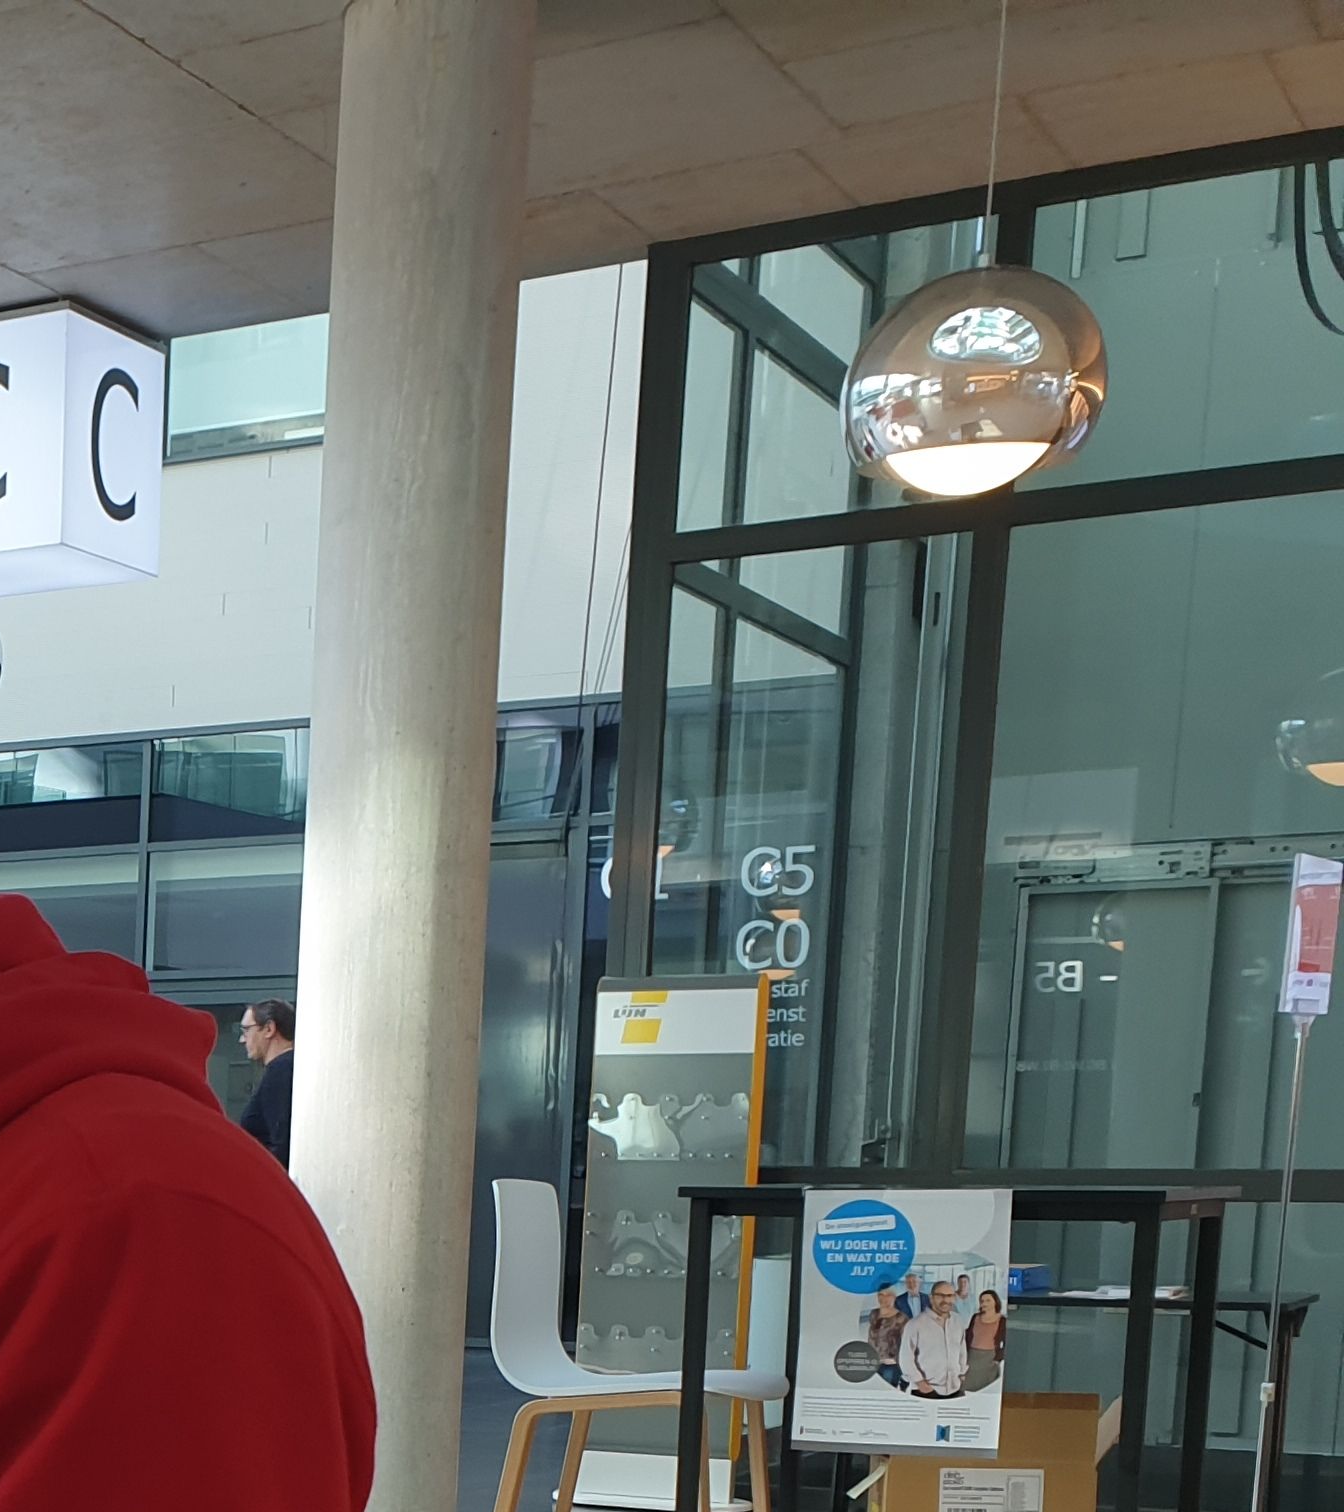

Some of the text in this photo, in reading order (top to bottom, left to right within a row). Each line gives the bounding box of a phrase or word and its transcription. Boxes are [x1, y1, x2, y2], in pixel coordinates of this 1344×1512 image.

[90, 367, 139, 522] C
[740, 844, 816, 897] C5
[735, 918, 811, 970] C0
[766, 1006, 807, 1023] enst
[826, 1253, 900, 1263] EN WAT DOE
[844, 1239, 878, 1250] DOEN
